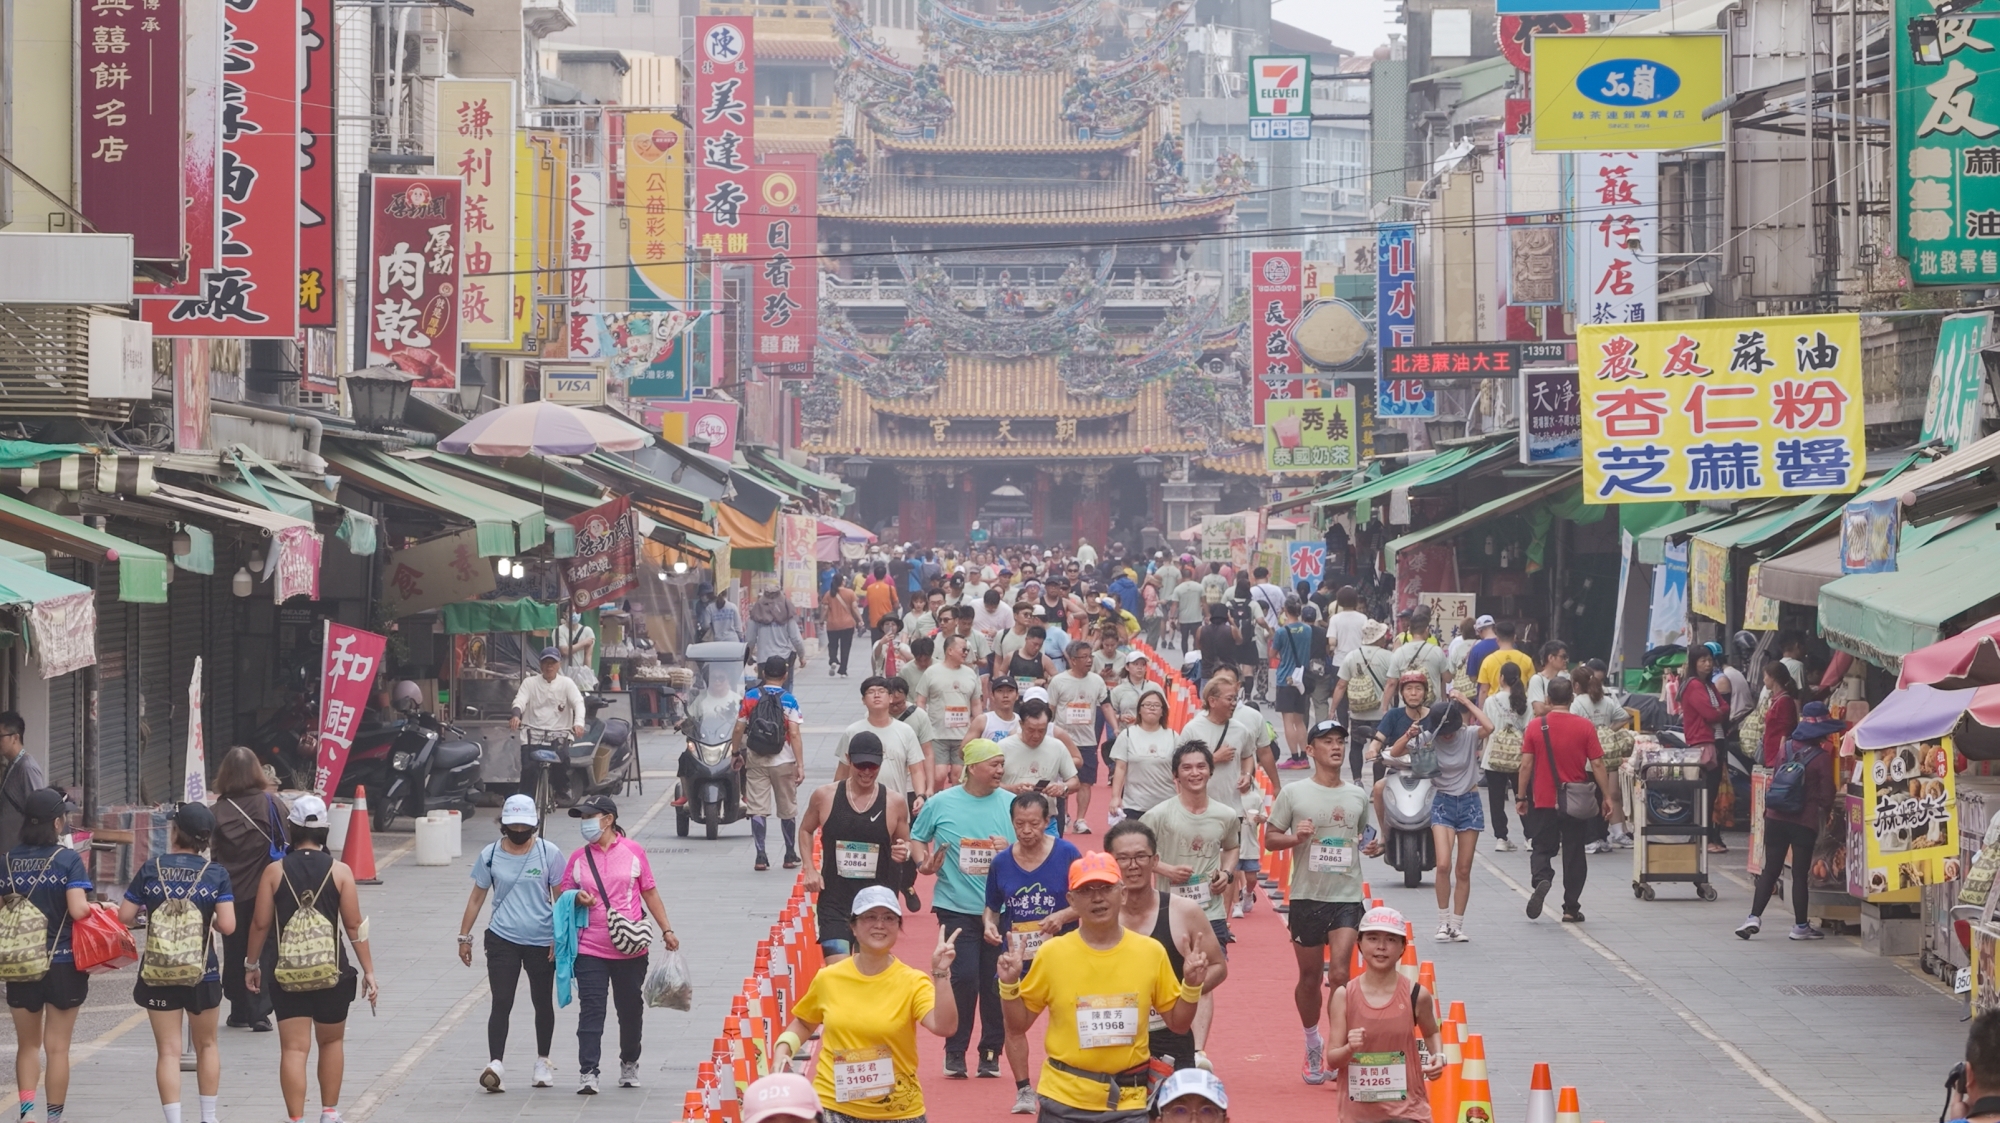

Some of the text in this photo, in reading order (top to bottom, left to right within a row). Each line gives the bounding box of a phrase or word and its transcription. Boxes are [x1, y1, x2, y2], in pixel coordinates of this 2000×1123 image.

[710, 27, 739, 58] 陳
[1572, 110, 1685, 120] 綠茶連鎖專賣店
[704, 78, 748, 227] 美達香
[646, 172, 666, 260] 公益彩券
[424, 224, 454, 275] 厚切
[702, 233, 748, 254] 囍餅
[1920, 250, 1998, 275] 批發零售
[763, 219, 801, 328] 日香珍
[374, 241, 431, 350] 肉乾
[760, 335, 800, 354] 囍餅
[557, 380, 591, 392] VISA
[1596, 381, 1848, 436] 杏仁粉
[1274, 446, 1349, 465] 泰國奶茶
[1368, 913, 1399, 926] ciele
[1956, 975, 1971, 989] 350
[1092, 1010, 1123, 1020] 陳慶芳
[1091, 1021, 1124, 1031] 31968
[847, 1074, 879, 1085] 31967
[1360, 1078, 1391, 1086] 21265
